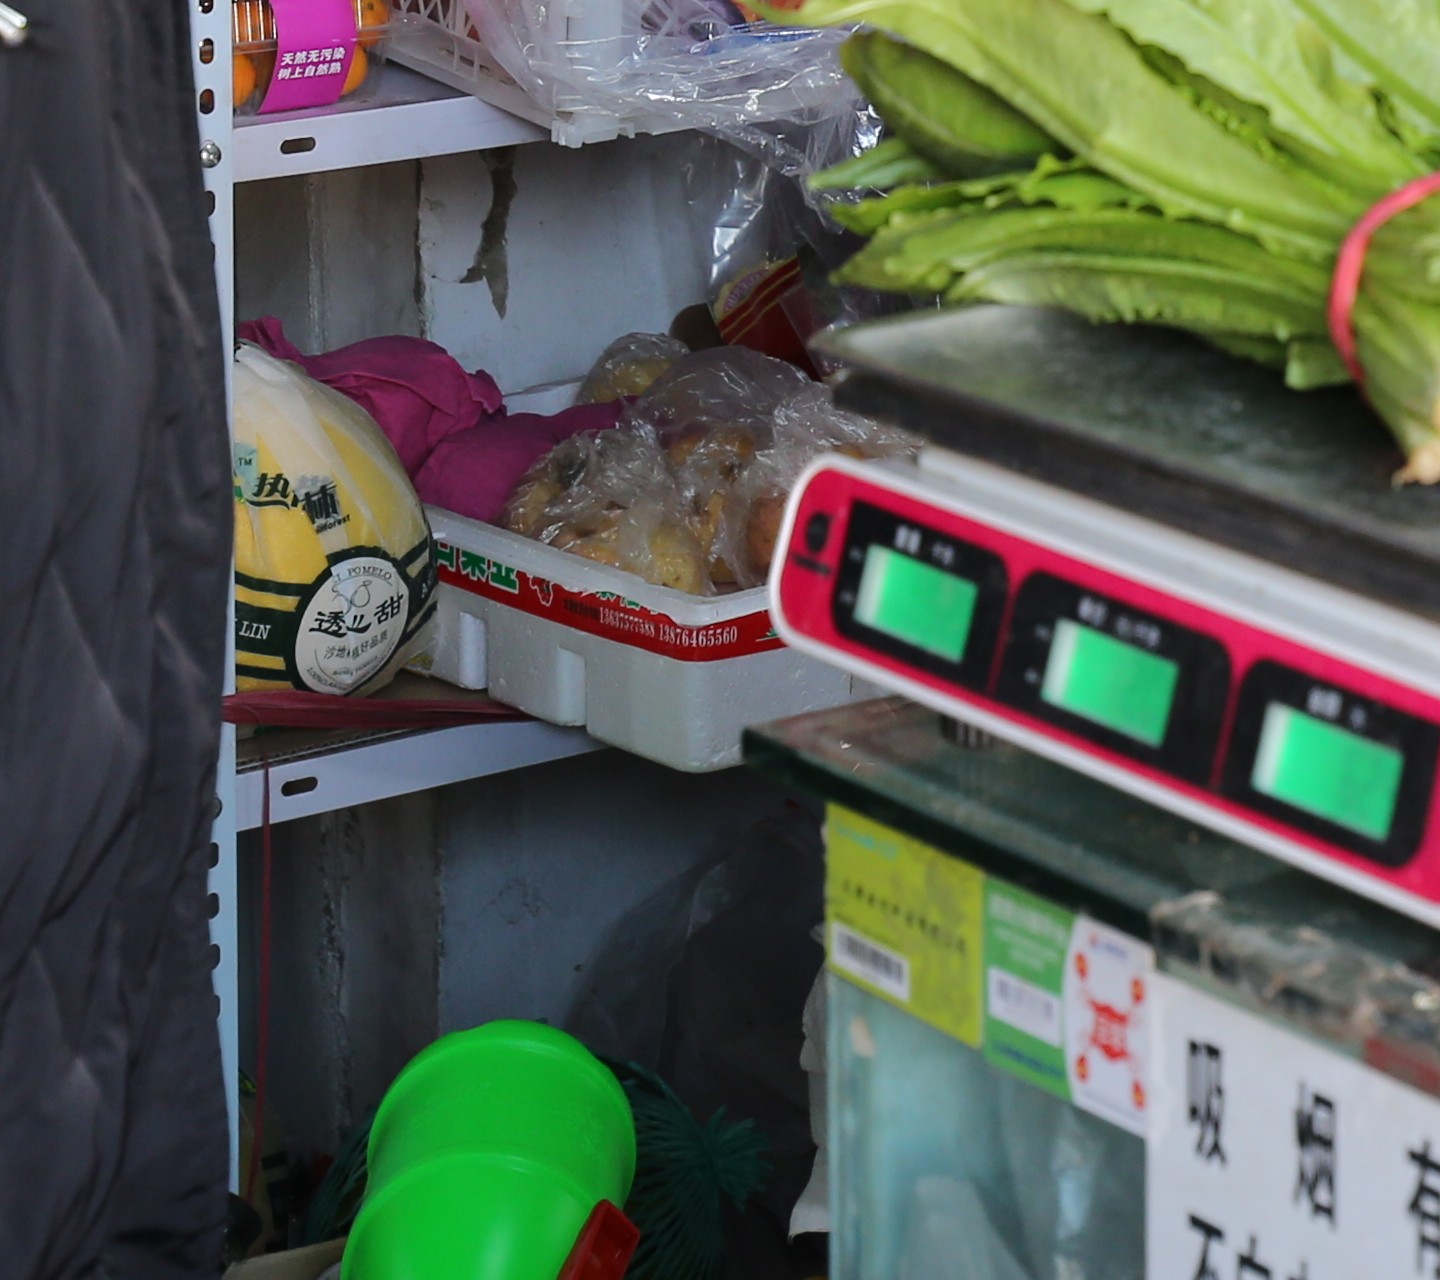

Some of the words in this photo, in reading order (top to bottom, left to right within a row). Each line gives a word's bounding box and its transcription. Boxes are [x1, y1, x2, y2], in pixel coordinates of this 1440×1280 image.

[281, 47, 346, 66] 天然无污染
[278, 61, 342, 81] 树上自然熟
[347, 565, 392, 581] POMELO
[659, 624, 738, 648] 13876465560
